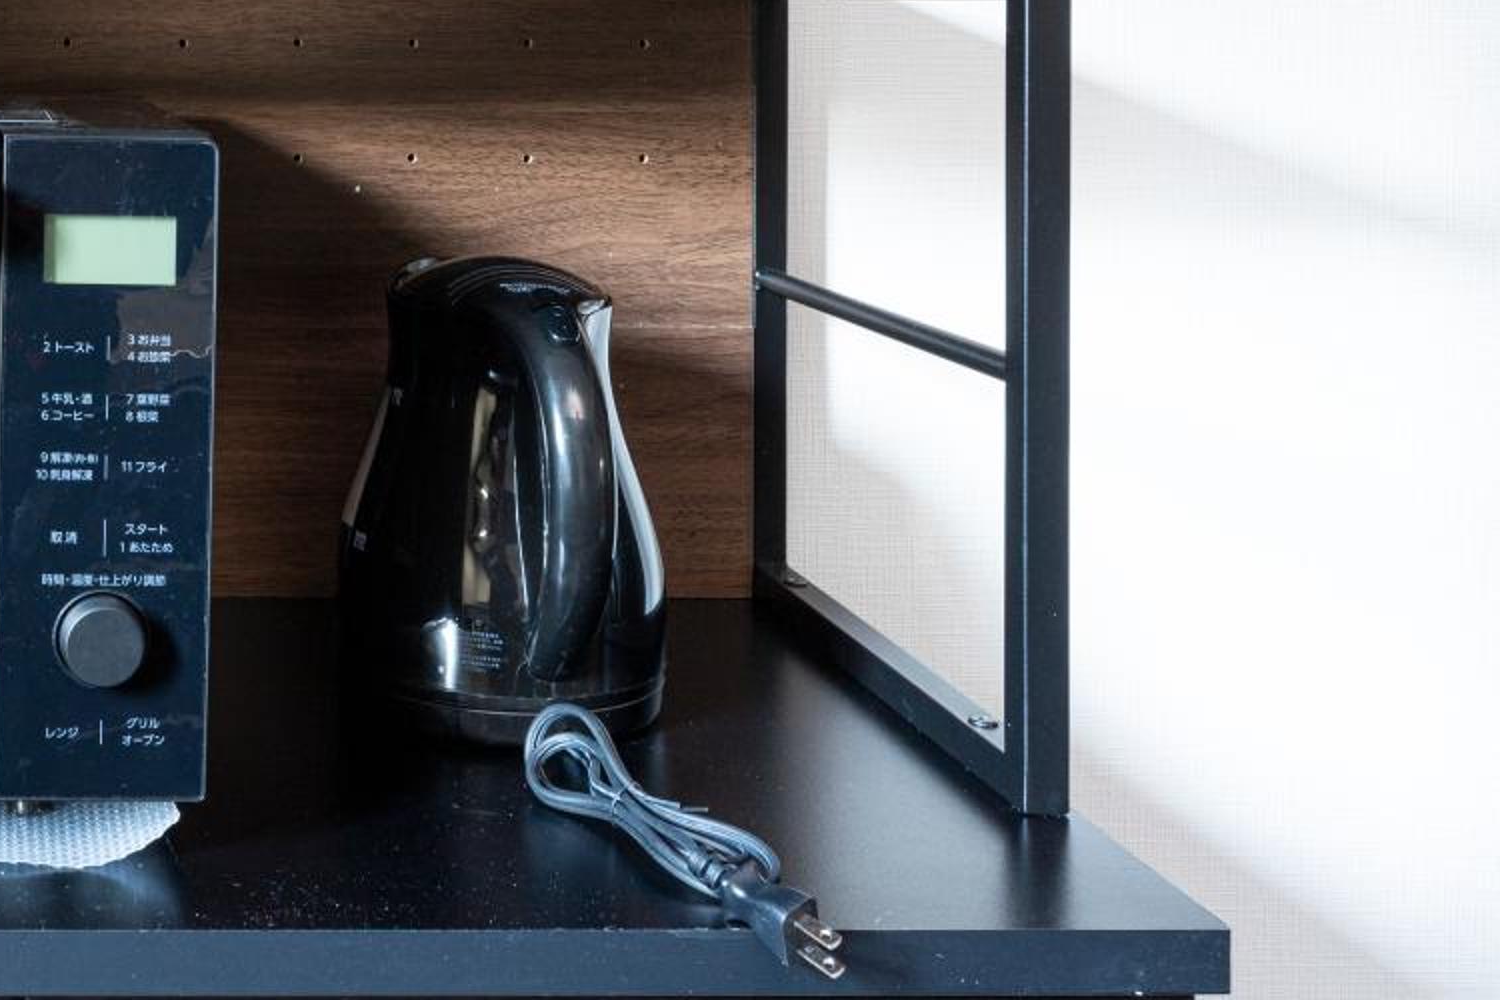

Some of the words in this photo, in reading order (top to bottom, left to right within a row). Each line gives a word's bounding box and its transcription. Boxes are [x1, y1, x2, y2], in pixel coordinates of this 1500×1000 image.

[124, 523, 168, 535] スタート
[126, 717, 160, 729] グリル
[45, 727, 79, 739] レンジ
